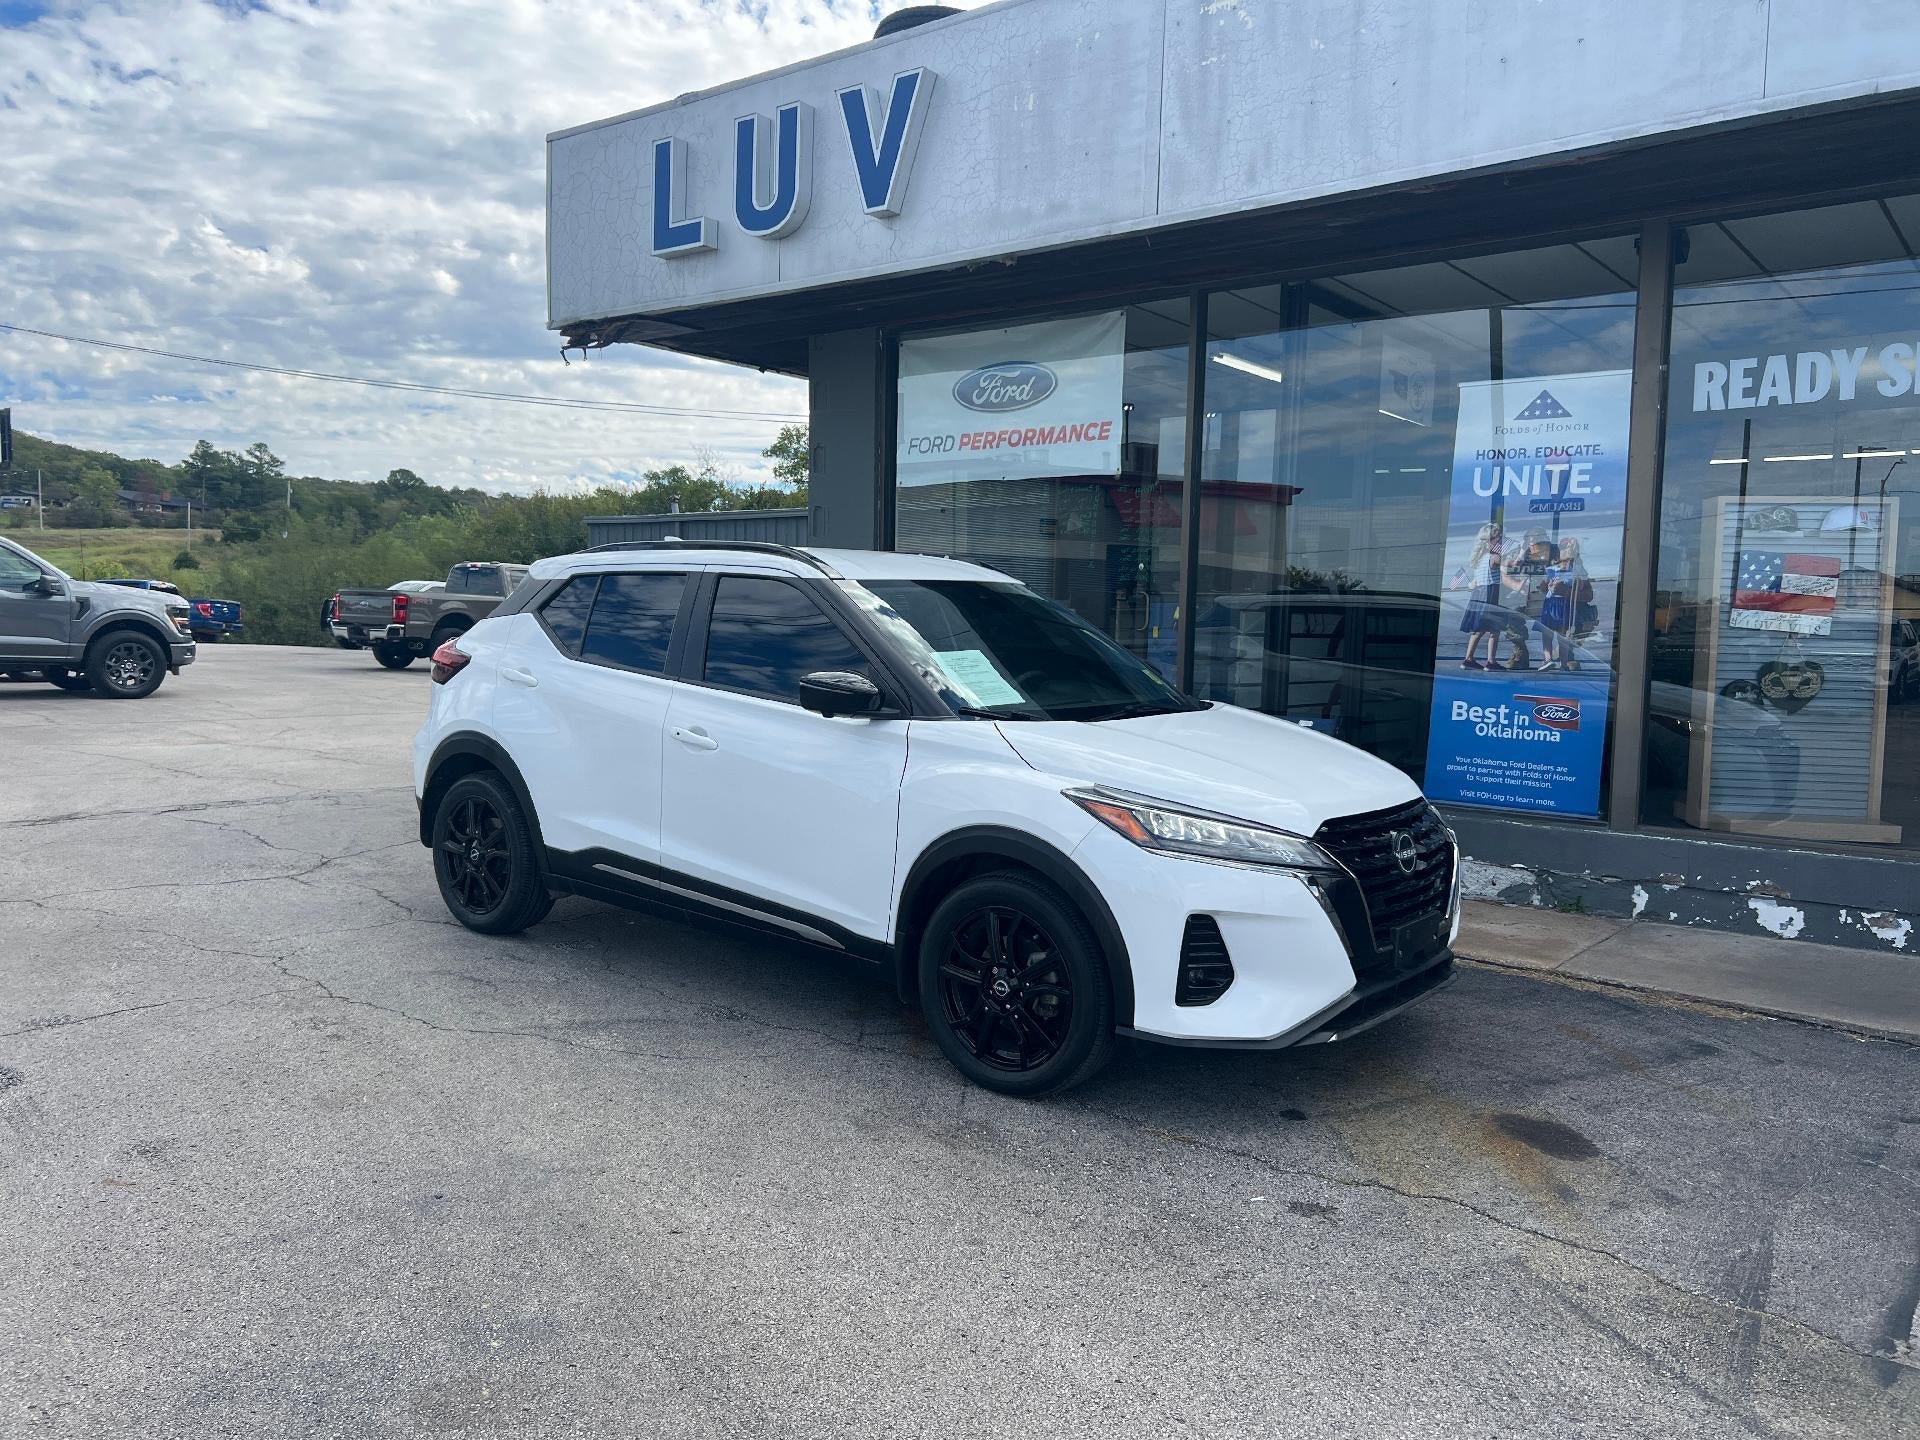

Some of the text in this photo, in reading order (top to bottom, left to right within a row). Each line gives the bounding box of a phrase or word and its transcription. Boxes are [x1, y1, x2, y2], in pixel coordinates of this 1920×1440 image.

[651, 67, 937, 259] LUV
[972, 371, 1036, 404] Ford
[1693, 346, 1868, 412] READY
[908, 421, 1112, 454] FORD PERFORMANCE
[1533, 424, 1543, 435] of
[1476, 444, 1604, 460] HONOR. EDUCATE.
[1473, 463, 1601, 496] UNITE.
[1451, 701, 1529, 726] Best in
[1541, 705, 1572, 719] Ford
[1475, 723, 1560, 742] Oklahoma
[1447, 764, 1467, 772] proud
[1478, 767, 1503, 776] partner
[1522, 770, 1542, 779] Folds
[1544, 772, 1551, 780] of
[1553, 773, 1576, 782] Honor
[1472, 757, 1507, 767] Oklahoma
[1509, 761, 1526, 769] Ford
[1528, 762, 1554, 772] Dealers
[1476, 776, 1503, 784] support
[1505, 777, 1521, 785] their
[1523, 780, 1552, 788] mission.
[1460, 789, 1475, 797] Visit
[1515, 795, 1533, 803] learn
[1535, 798, 1556, 807] more.
